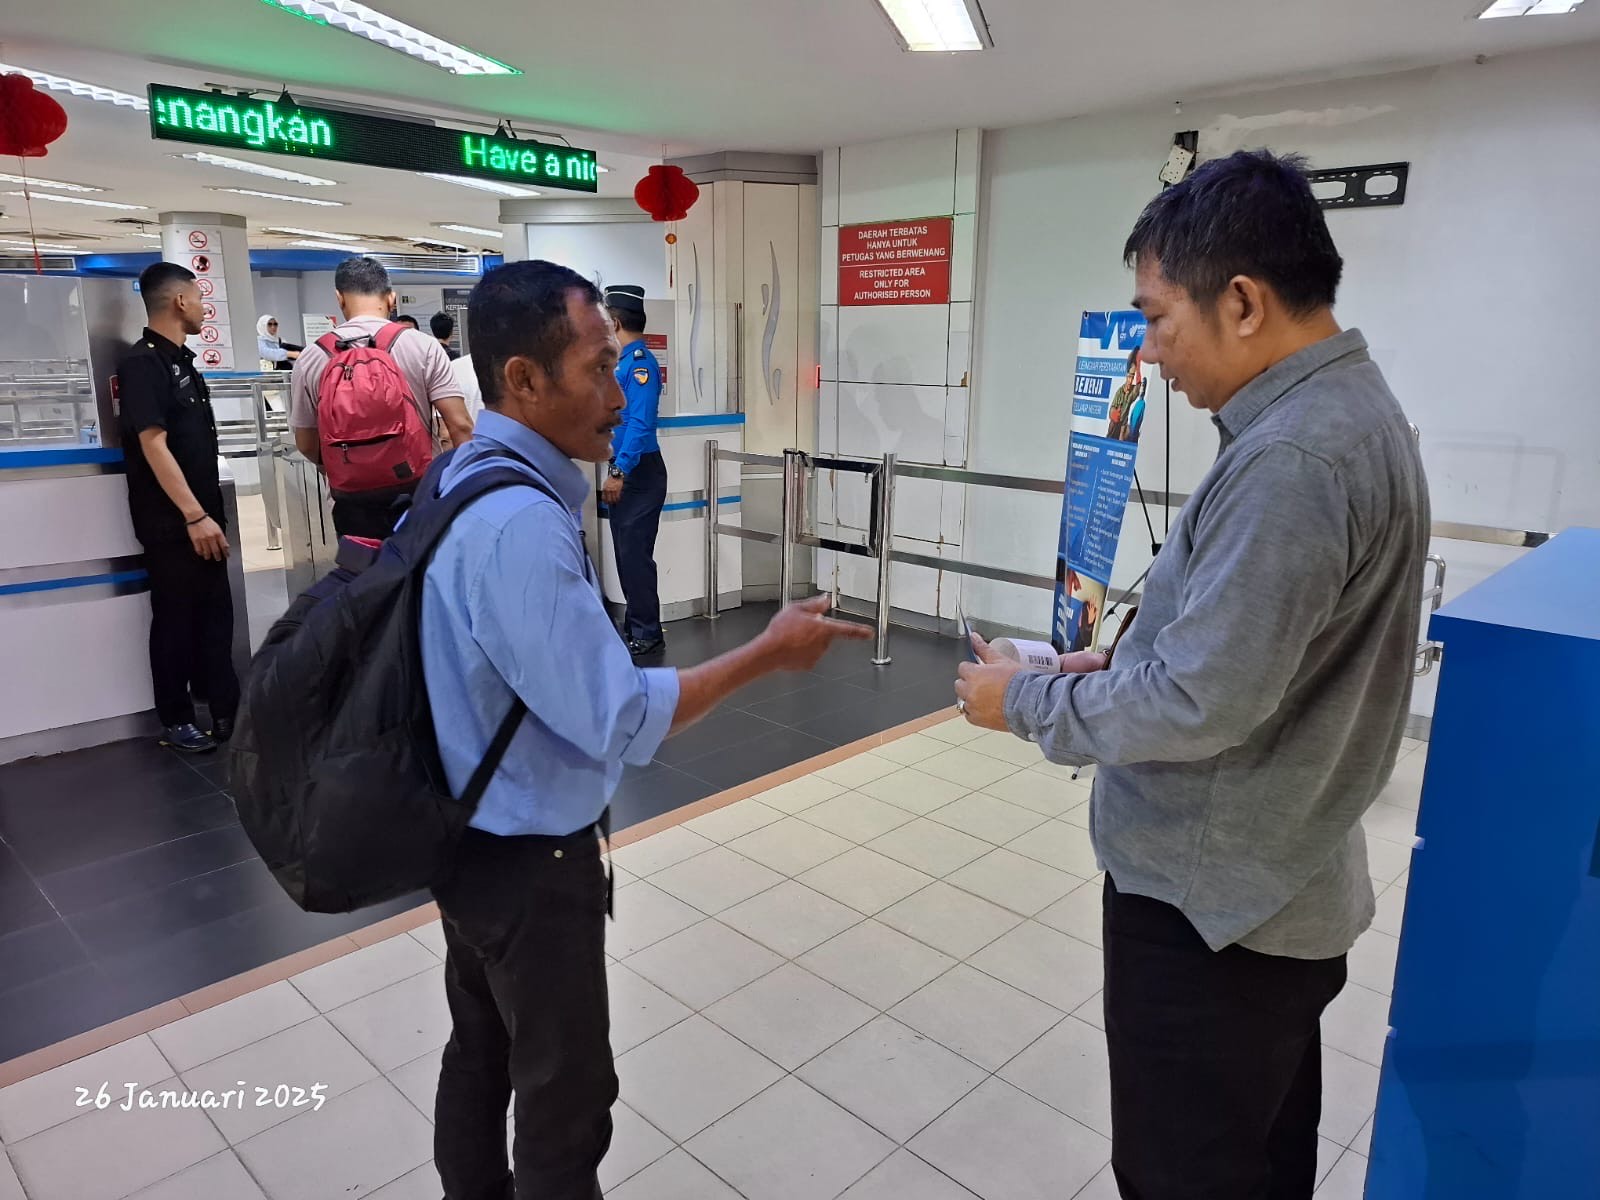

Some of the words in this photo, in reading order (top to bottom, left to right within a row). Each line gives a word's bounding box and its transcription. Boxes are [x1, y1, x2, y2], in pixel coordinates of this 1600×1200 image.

[463, 135, 537, 174] Have
[545, 152, 560, 177] a
[858, 229, 888, 240] DAERAH
[889, 225, 928, 237] TERBATAS
[866, 240, 891, 250] HANYA
[892, 238, 918, 248] UNTUK
[842, 251, 874, 262] PETUGAS
[875, 250, 895, 260] YANG
[896, 247, 945, 259] BERWENANG
[859, 268, 904, 279] RESTRICTED
[904, 267, 926, 277] AREA
[874, 279, 893, 289] ONLY
[894, 279, 910, 288] FOR
[854, 290, 899, 300] AUTHORISED
[900, 289, 931, 299] PERSON
